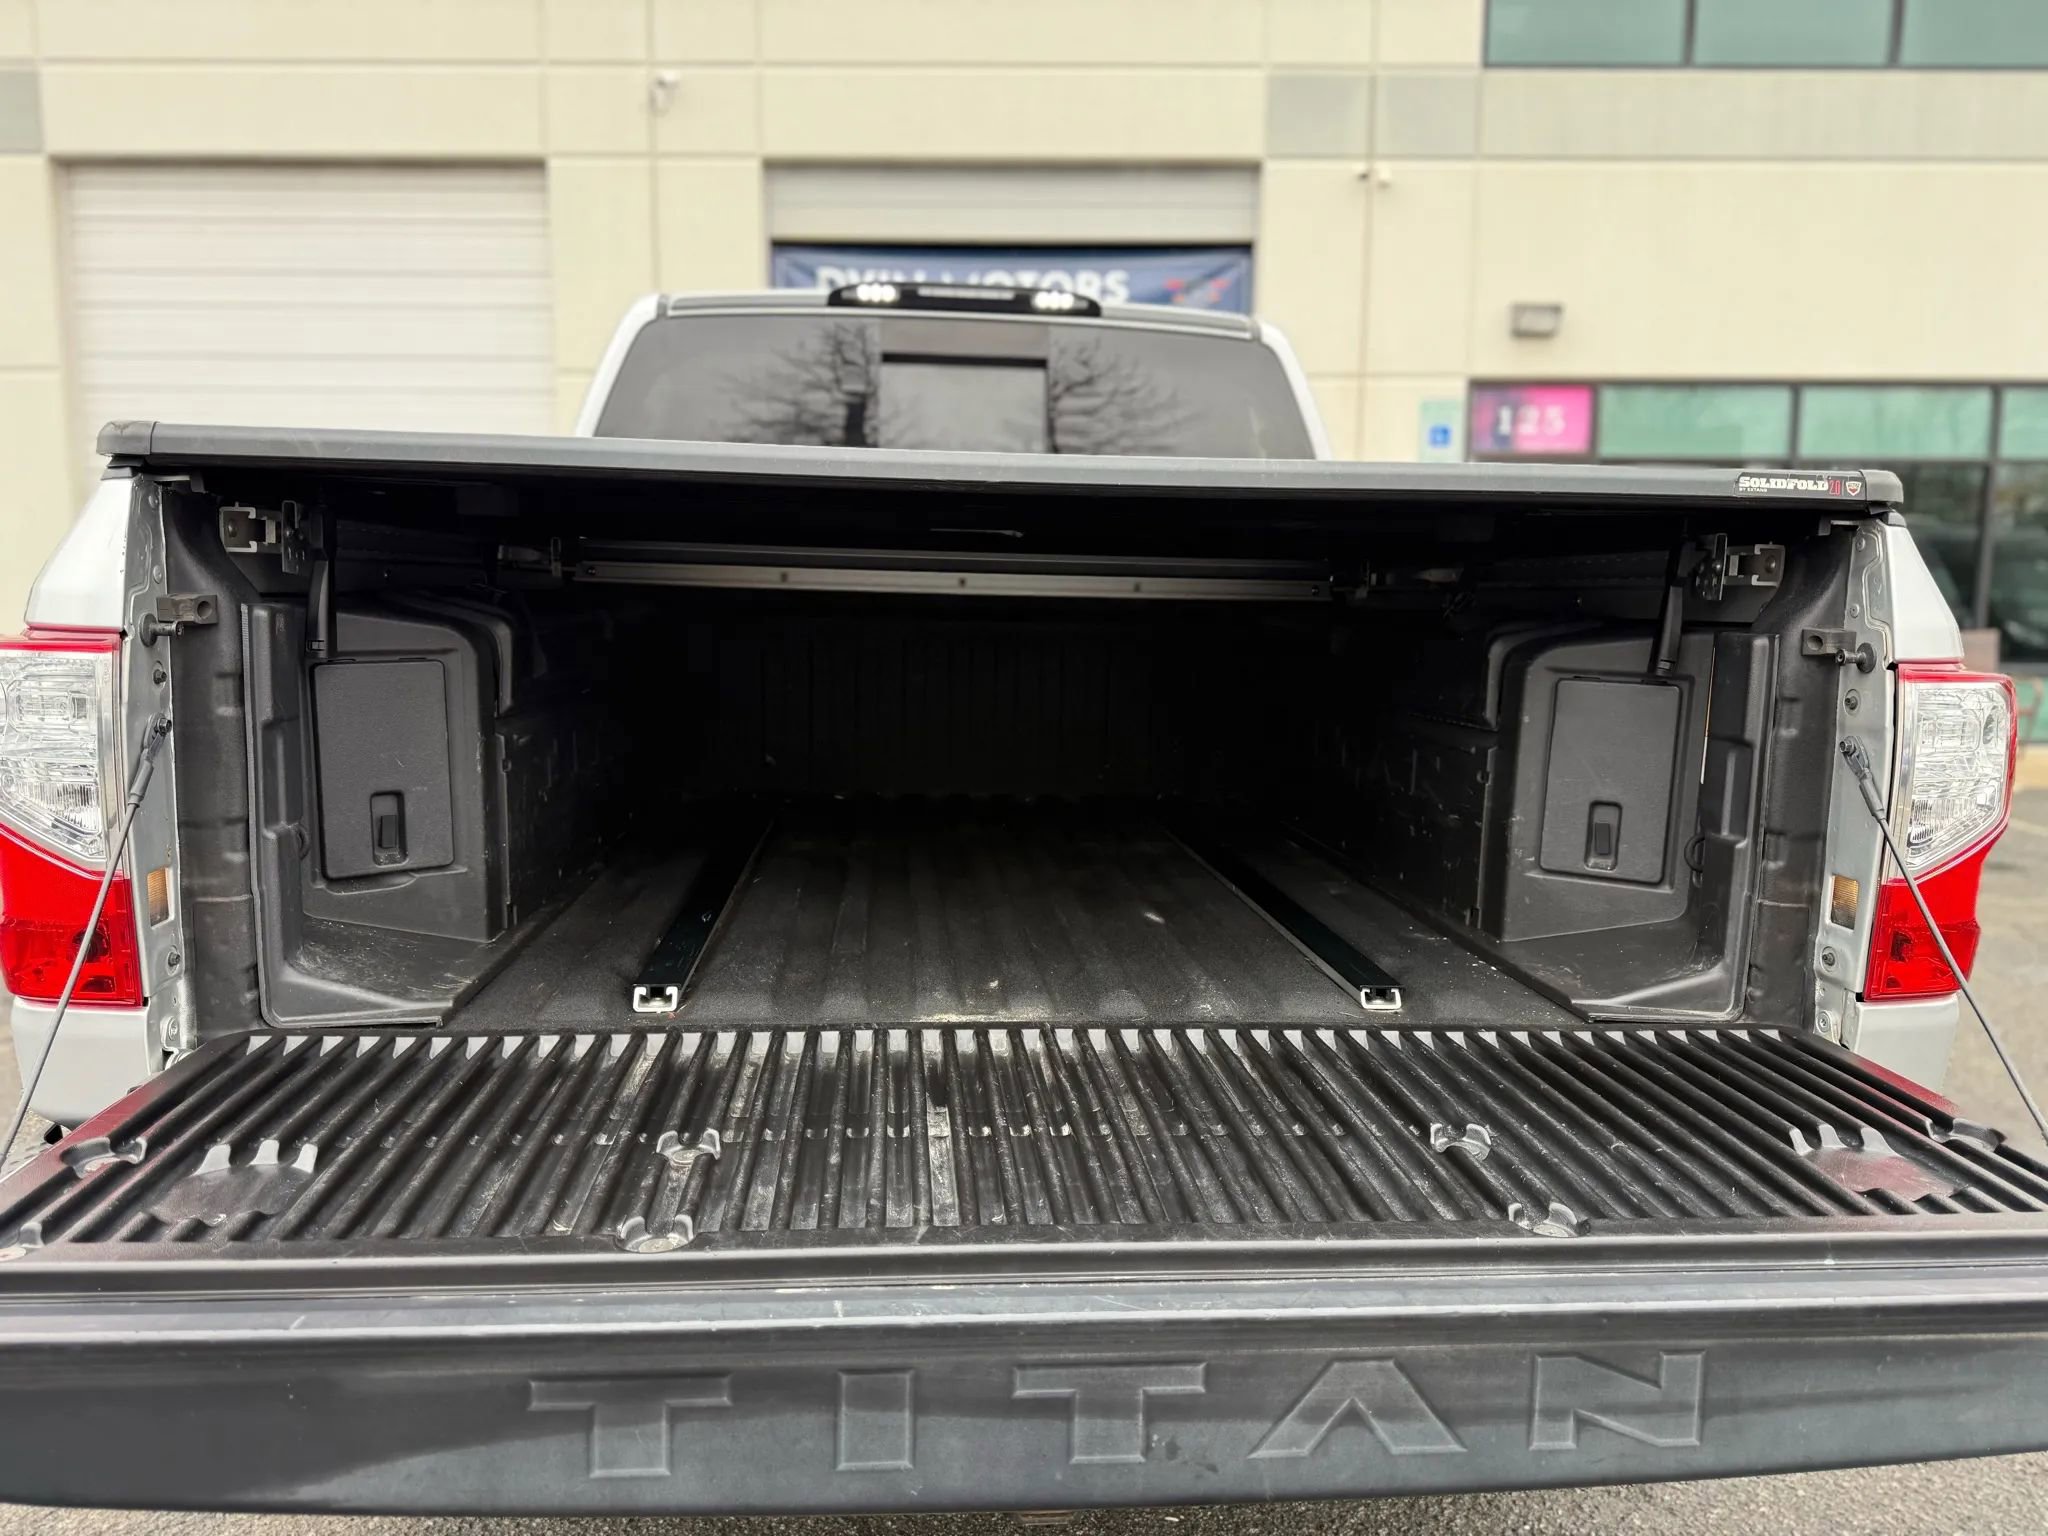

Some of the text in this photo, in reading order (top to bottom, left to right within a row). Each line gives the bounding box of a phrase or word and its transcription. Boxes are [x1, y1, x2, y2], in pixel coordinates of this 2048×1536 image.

[1499, 405, 1565, 435] 125
[1739, 476, 1828, 491] SOLIDFOLD
[528, 1350, 1707, 1478] TITAN
